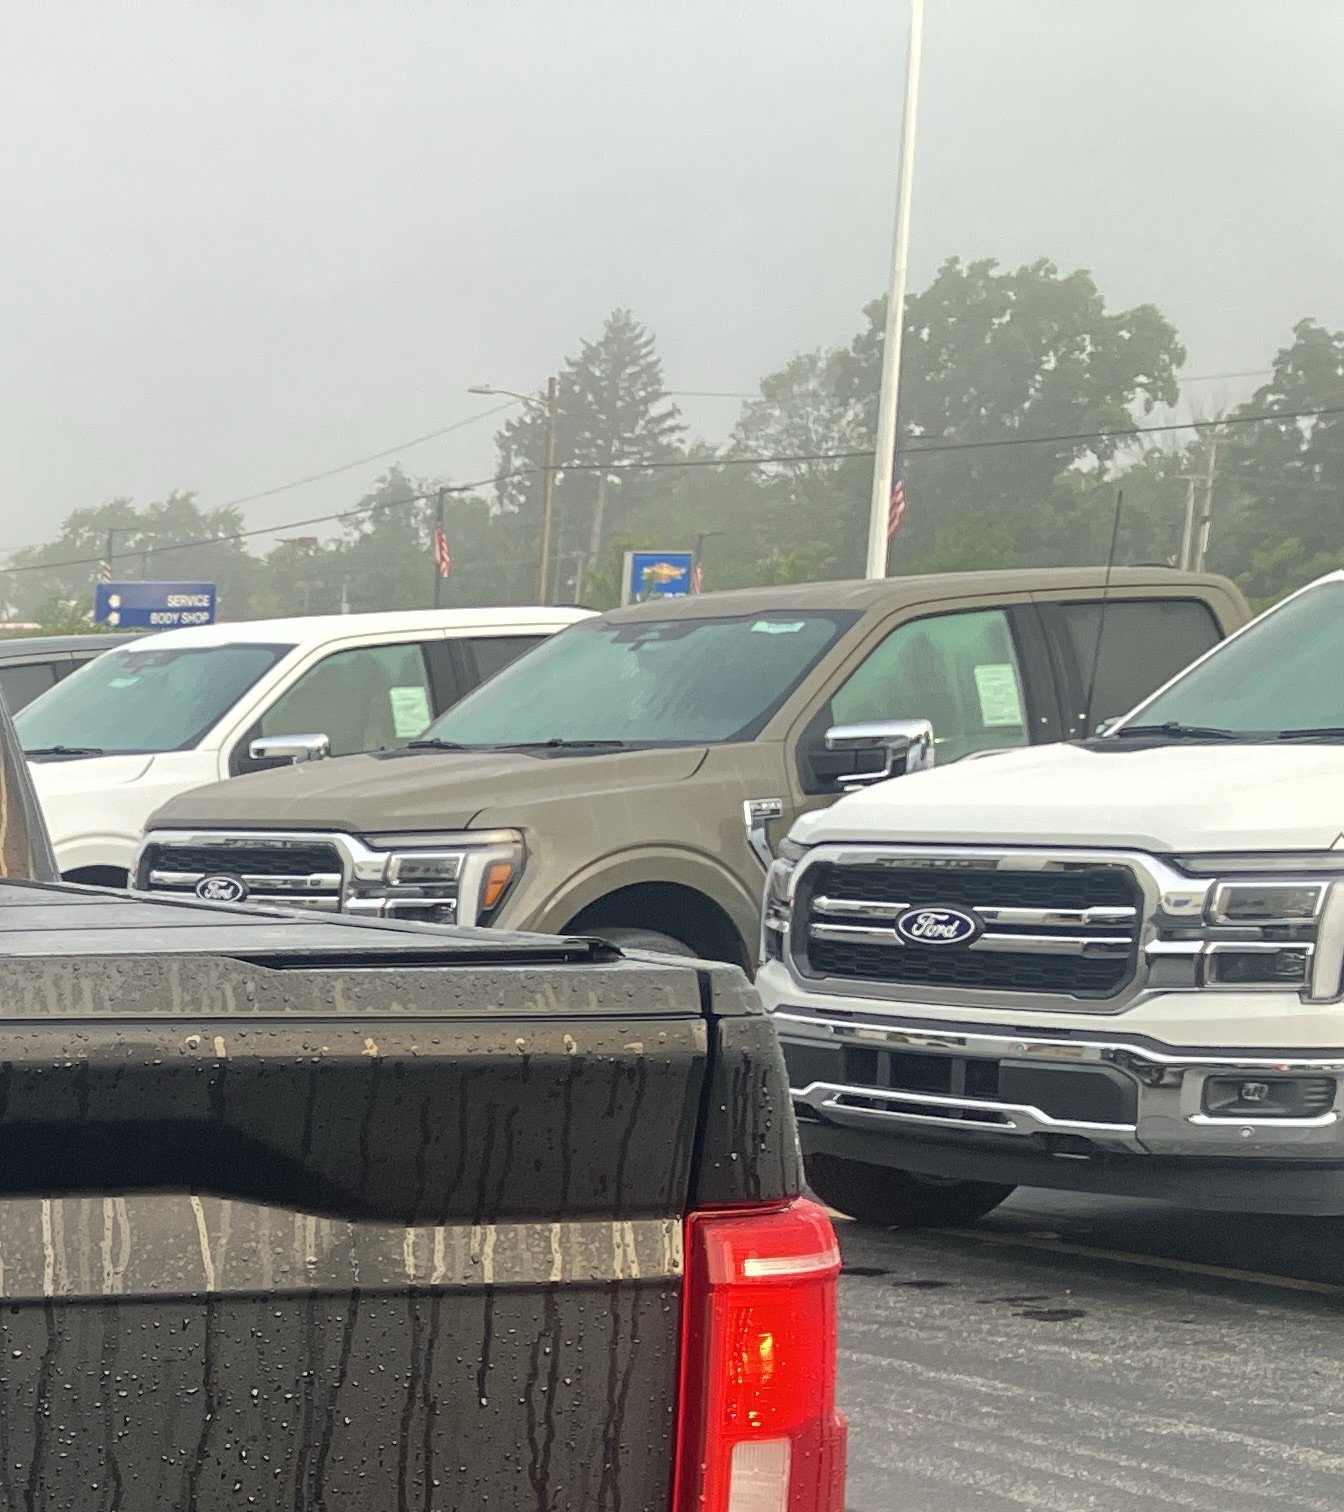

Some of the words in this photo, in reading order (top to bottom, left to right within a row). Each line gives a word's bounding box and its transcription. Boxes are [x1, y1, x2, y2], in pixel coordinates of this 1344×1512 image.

[167, 594, 210, 607] SERVICE
[150, 612, 179, 624] BODY
[180, 611, 210, 624] SHOP
[911, 912, 961, 938] Ford
